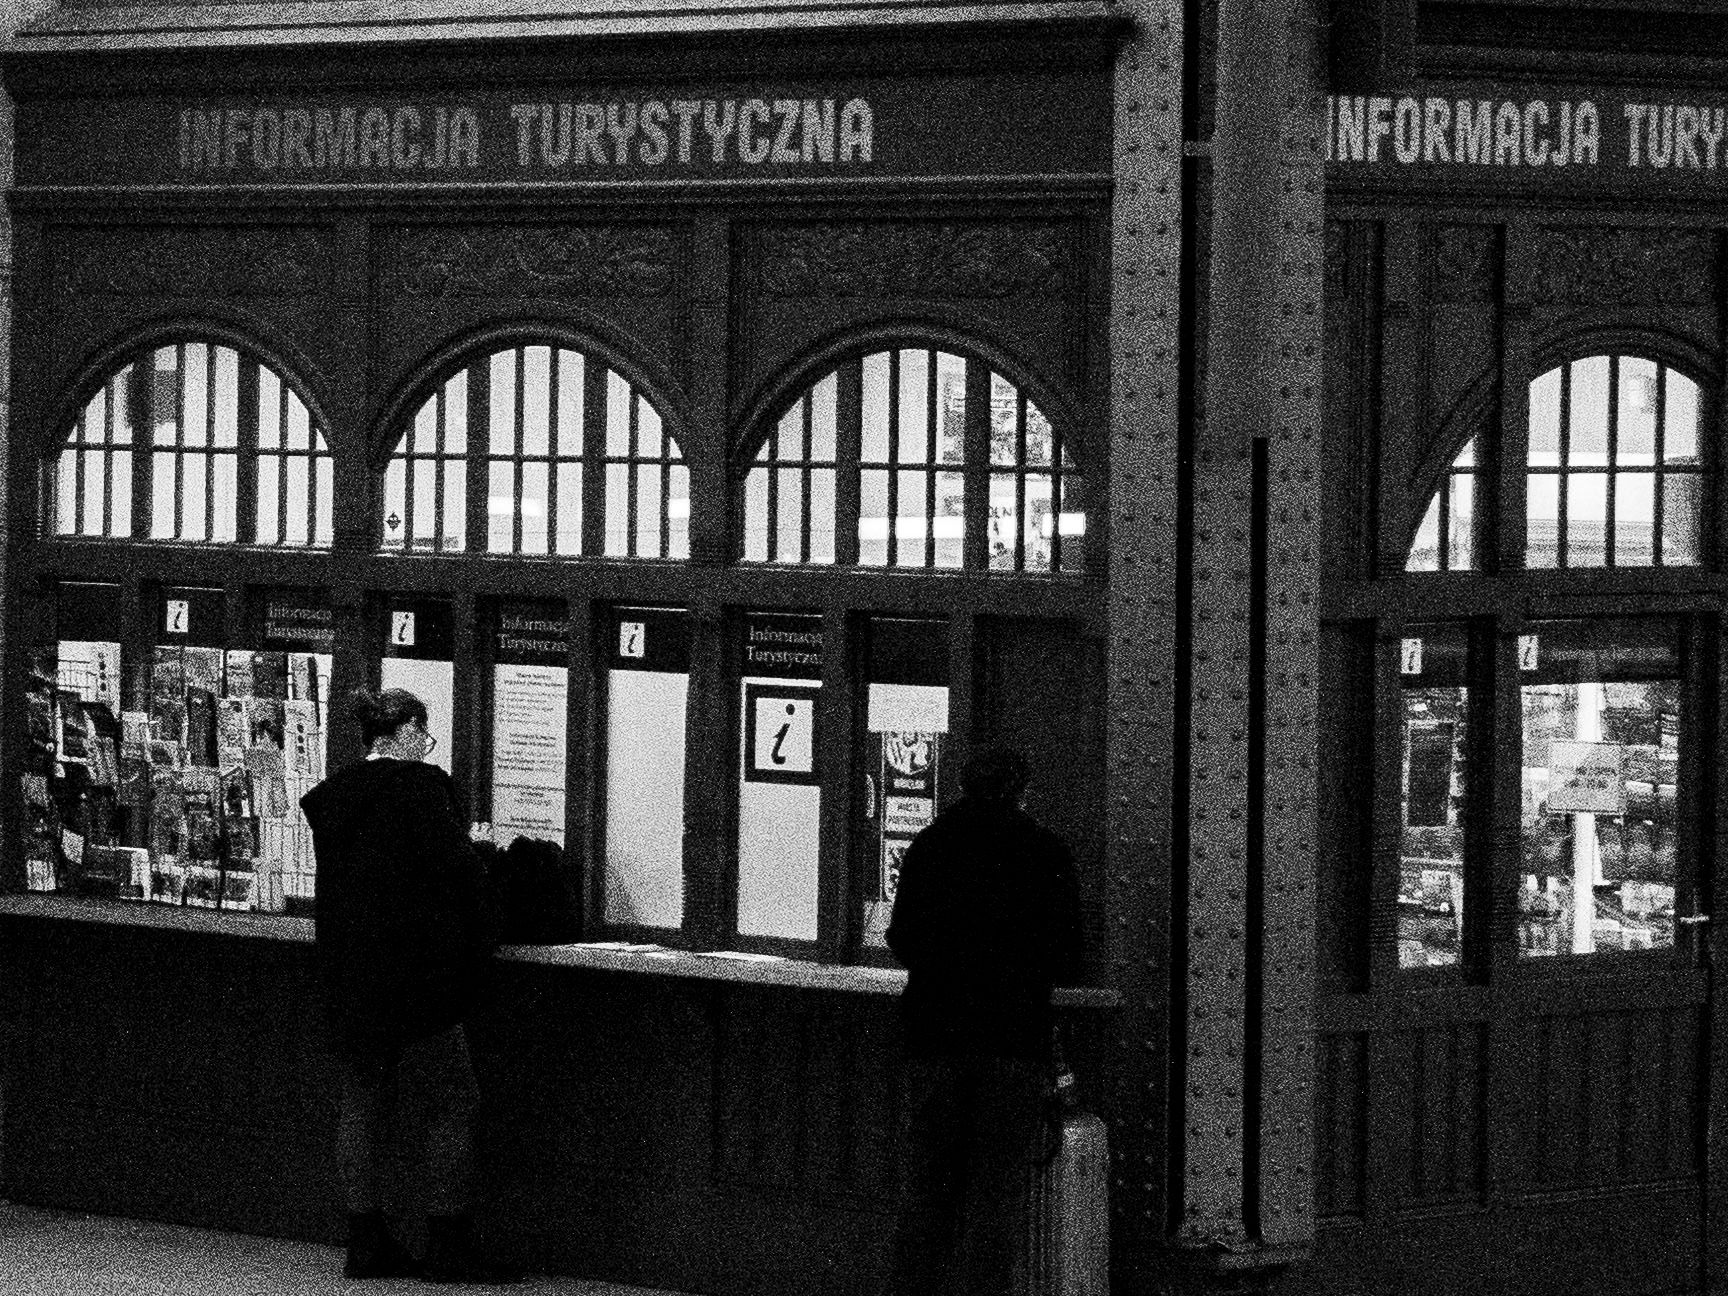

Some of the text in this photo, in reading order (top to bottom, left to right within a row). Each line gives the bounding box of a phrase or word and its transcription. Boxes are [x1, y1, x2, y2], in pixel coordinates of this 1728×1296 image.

[179, 95, 874, 171] INFORMACJA TURYSTYCZNA
[1325, 95, 1728, 171] INFORMACJA TURY
